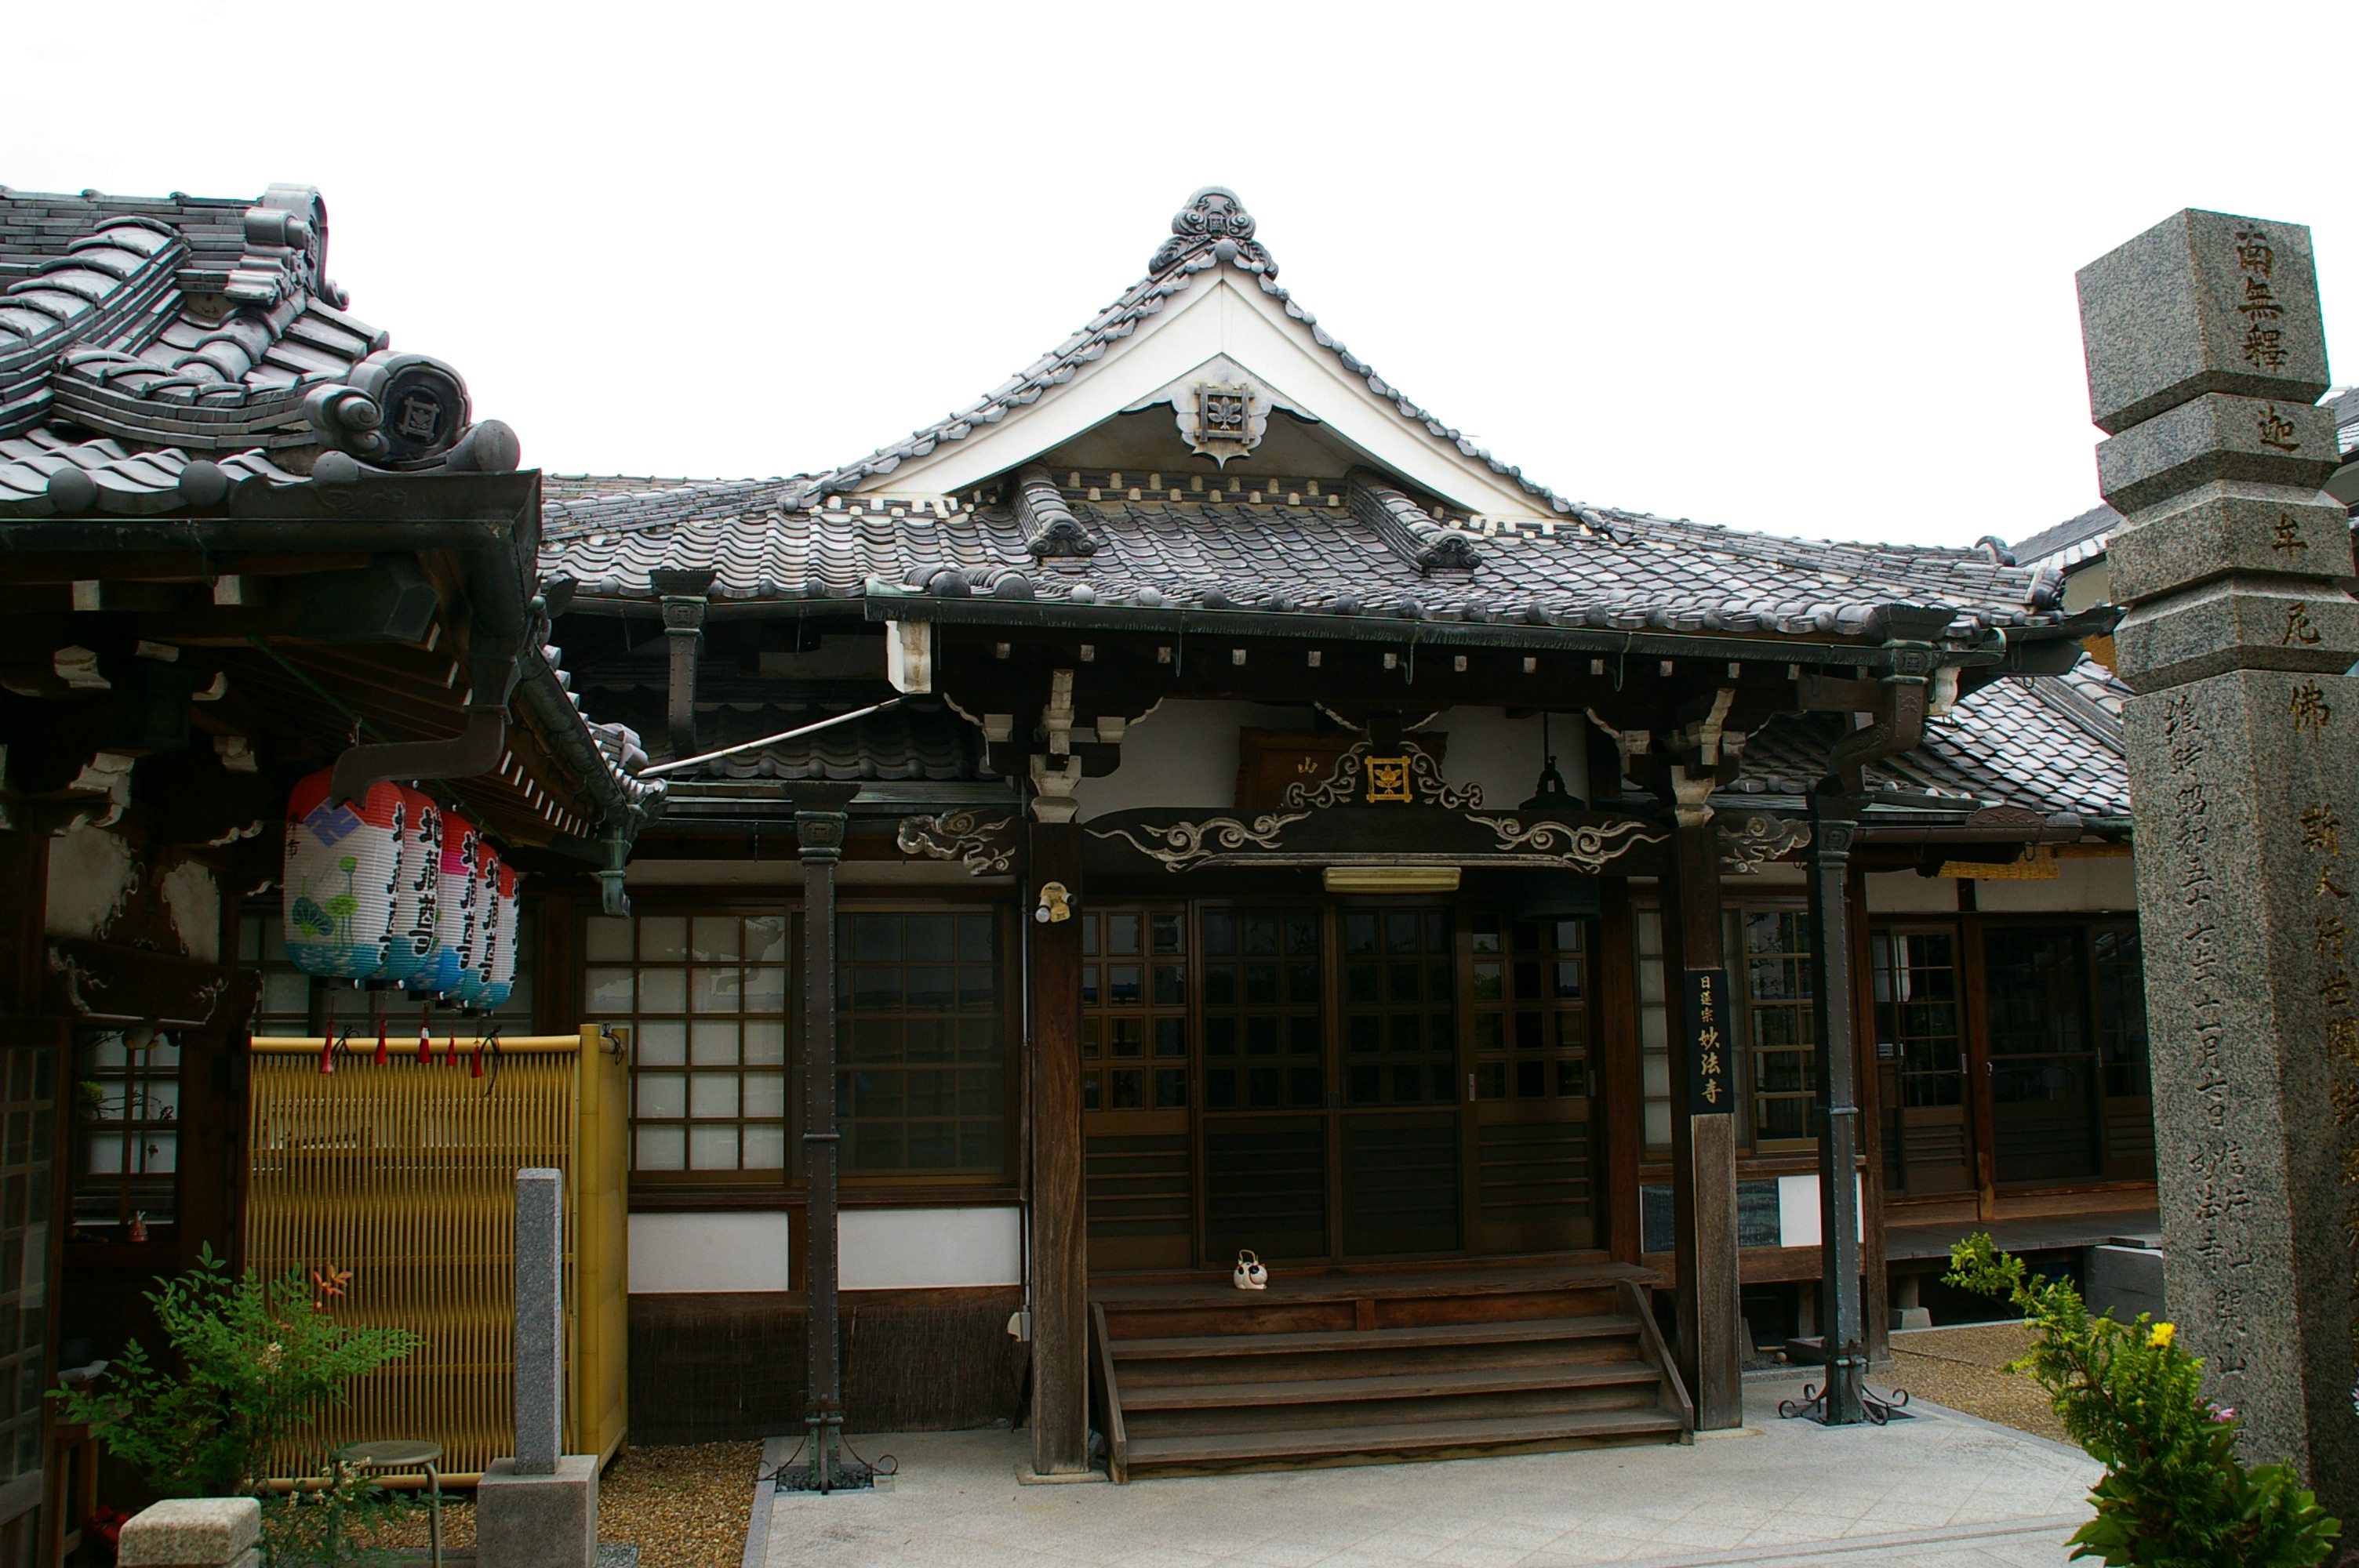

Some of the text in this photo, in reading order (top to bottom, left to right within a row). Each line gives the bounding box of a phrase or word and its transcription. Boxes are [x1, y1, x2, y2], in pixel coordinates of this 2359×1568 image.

[1297, 756, 1318, 774] 山
[1698, 1025, 1723, 1104] 妙法寺
